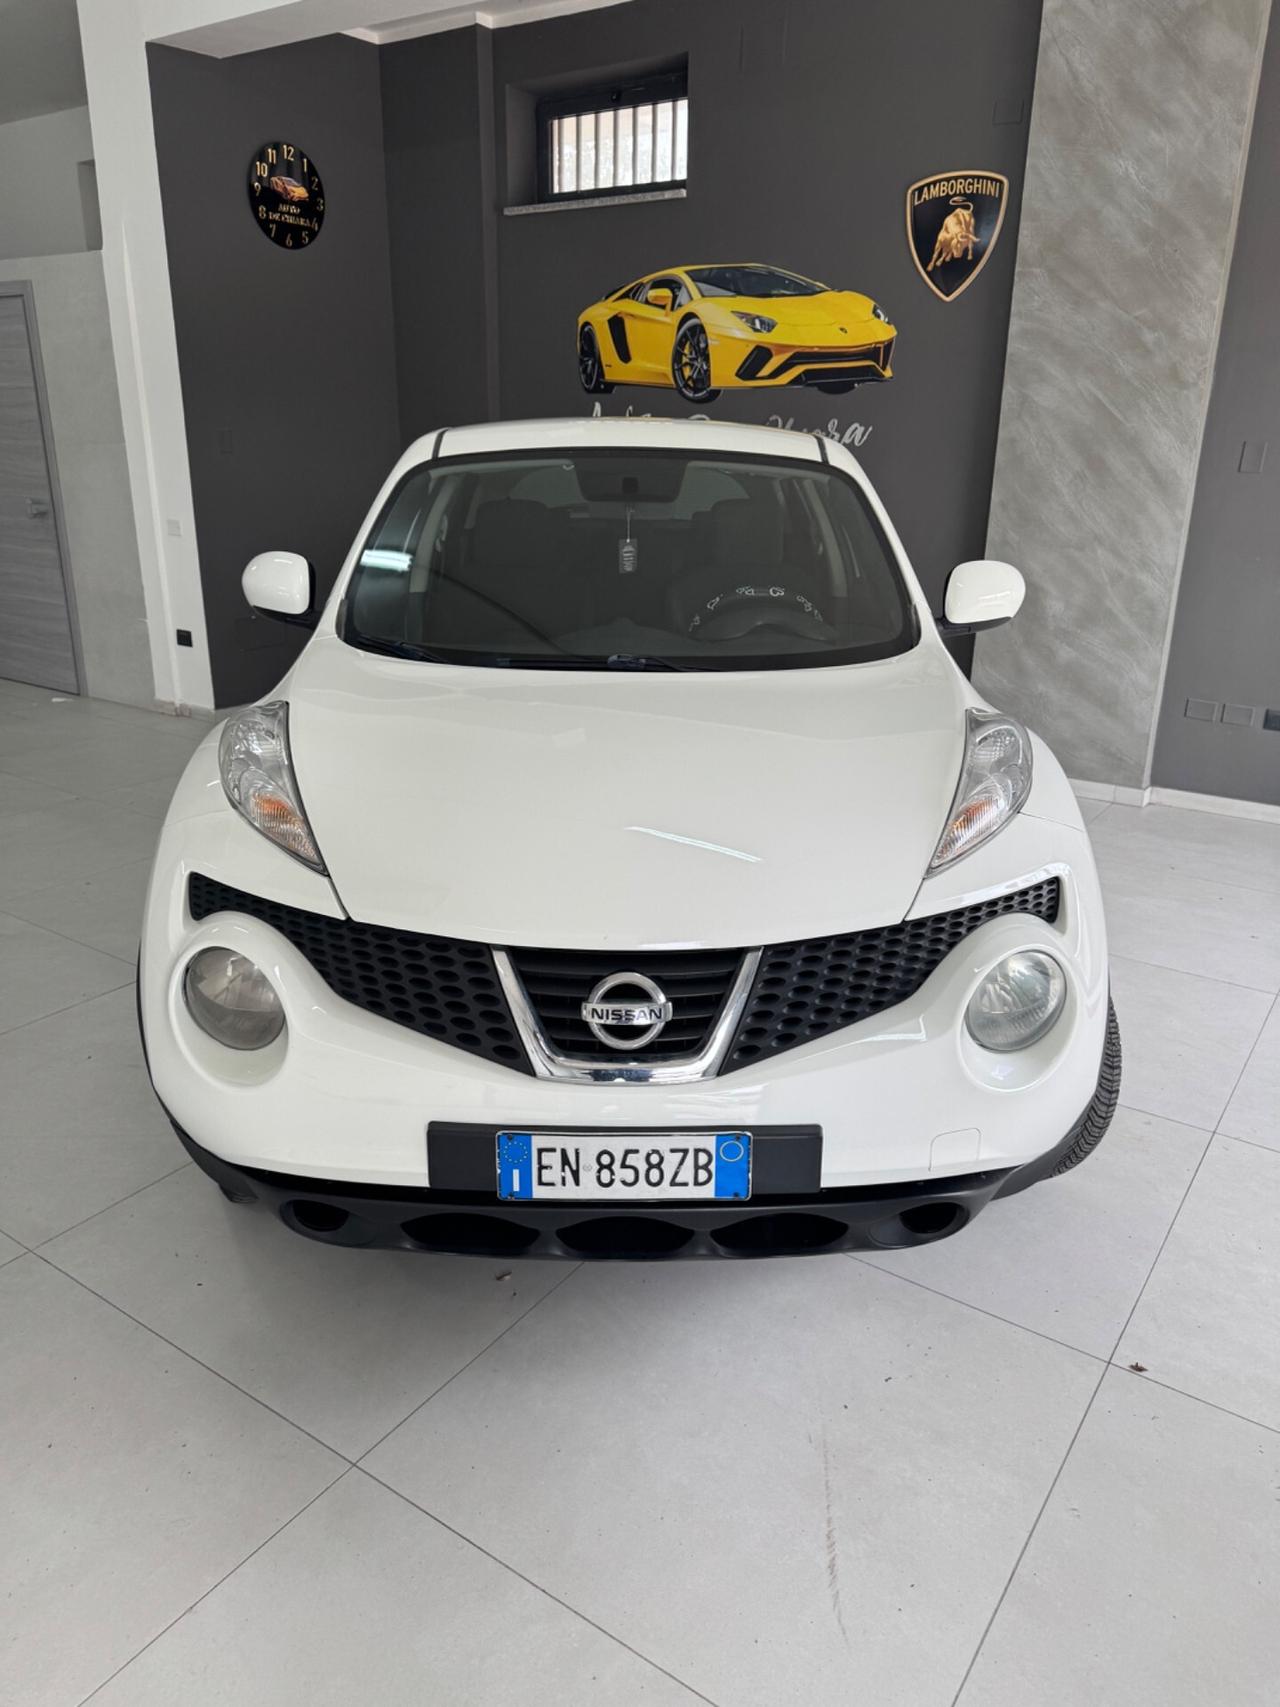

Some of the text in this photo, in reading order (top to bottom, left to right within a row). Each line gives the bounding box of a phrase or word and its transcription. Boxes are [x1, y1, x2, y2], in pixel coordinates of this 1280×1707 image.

[268, 148, 277, 164] 11
[283, 144, 295, 161] 12
[256, 161, 268, 178] 10
[303, 158, 308, 173] 1
[254, 182, 261, 197] 9
[312, 177, 319, 191] 2
[914, 178, 1000, 206] LAMBORGHINI
[258, 205, 266, 219] 8
[316, 198, 324, 212] 3
[269, 223, 276, 238] 7
[311, 217, 319, 232] 4
[286, 234, 293, 247] 6
[302, 231, 309, 244] 5
[591, 1008, 662, 1021] NISSAN
[536, 1147, 581, 1187] EN
[595, 1148, 714, 1188] 858ZB
